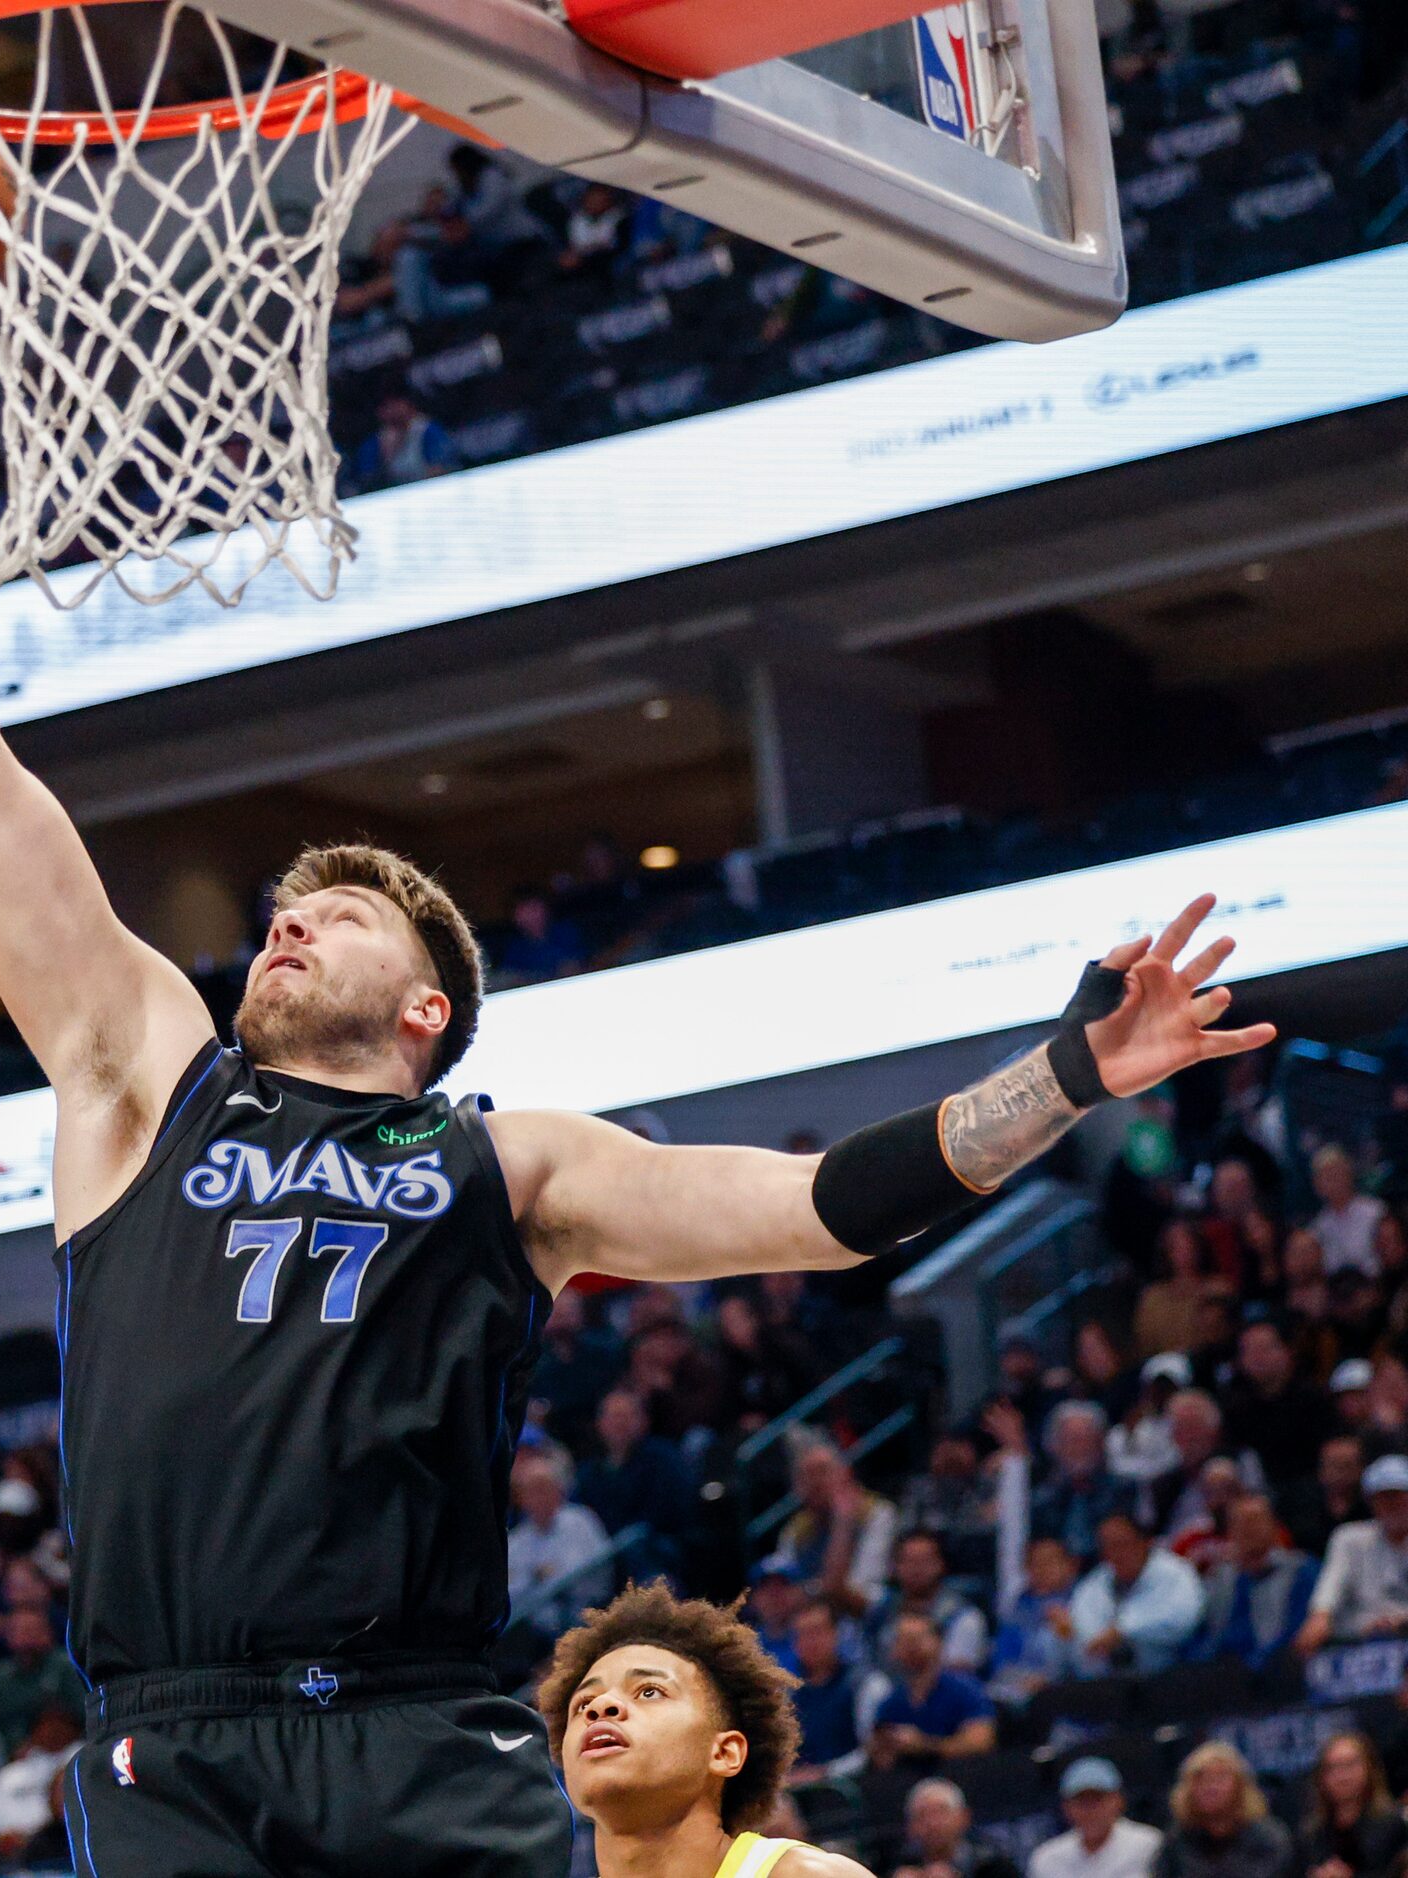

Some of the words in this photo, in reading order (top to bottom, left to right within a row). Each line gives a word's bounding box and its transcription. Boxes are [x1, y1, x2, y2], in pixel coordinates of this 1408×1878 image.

[377, 1119, 448, 1146] Chime
[182, 1138, 455, 1220] MAVS
[225, 1217, 389, 1323] 77
